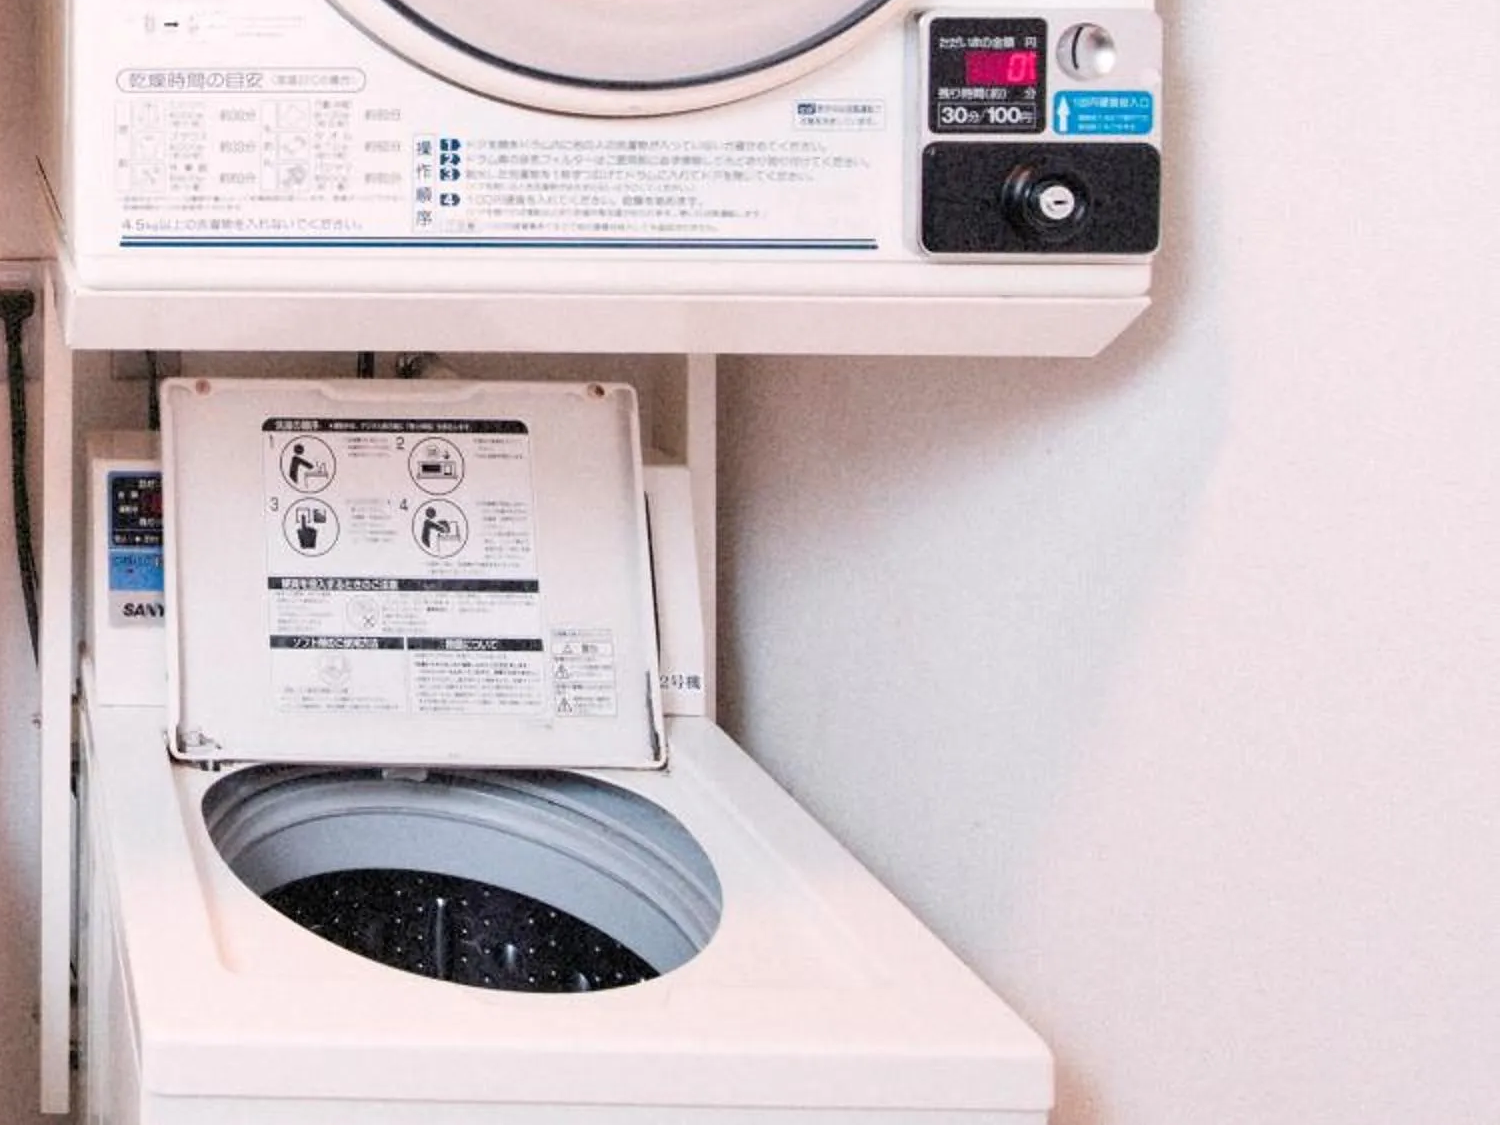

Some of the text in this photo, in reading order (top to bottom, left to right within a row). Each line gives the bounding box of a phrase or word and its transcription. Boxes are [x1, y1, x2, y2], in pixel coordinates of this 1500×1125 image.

[1024, 36, 1038, 49] 円
[128, 72, 263, 89] 乾燥時間の目安
[1024, 88, 1038, 100] 分
[396, 436, 405, 450] 2
[269, 497, 279, 512] 3
[399, 498, 408, 512] 4
[660, 674, 701, 690] 2号機
